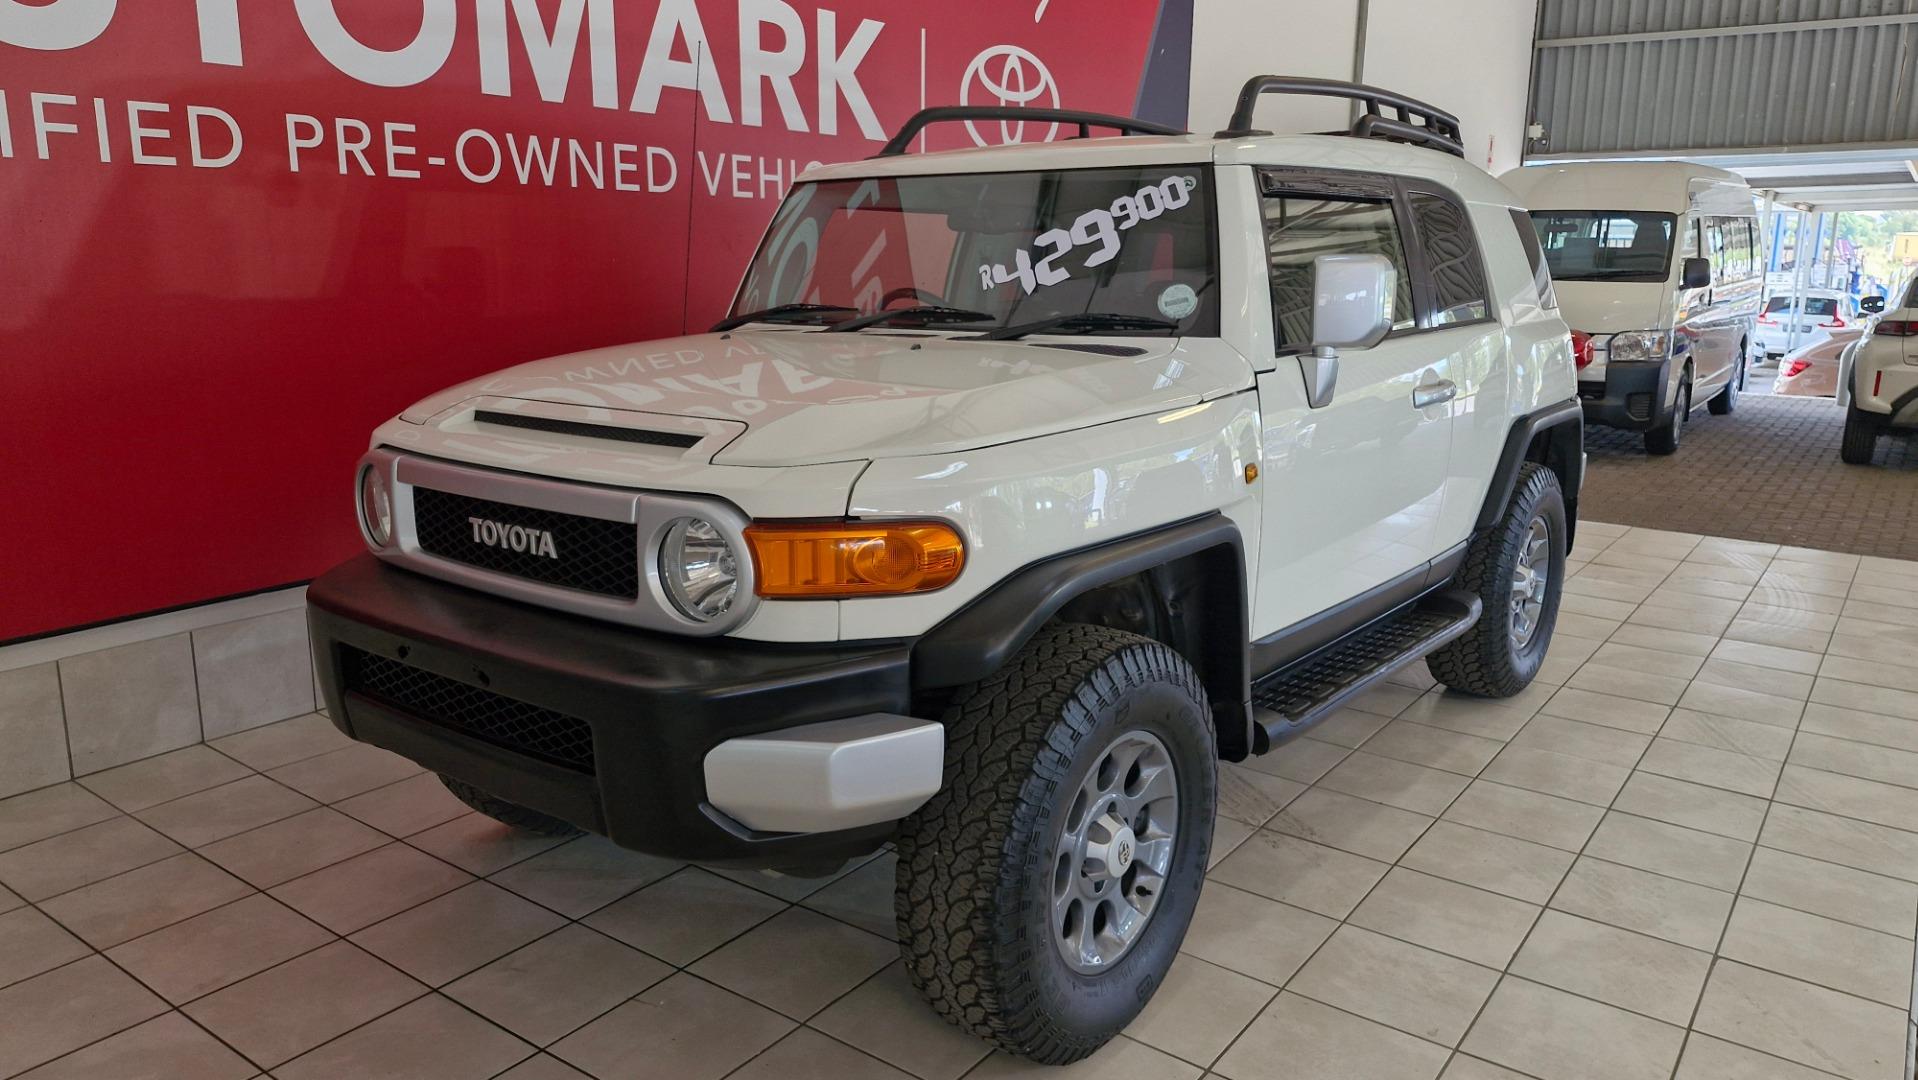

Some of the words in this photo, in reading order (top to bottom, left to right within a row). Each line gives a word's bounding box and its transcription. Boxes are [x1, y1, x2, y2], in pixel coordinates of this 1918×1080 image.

[285, 113, 678, 194] PRE-OWNED
[697, 150, 825, 200] VEHI
[468, 516, 559, 560] TOYOTA
